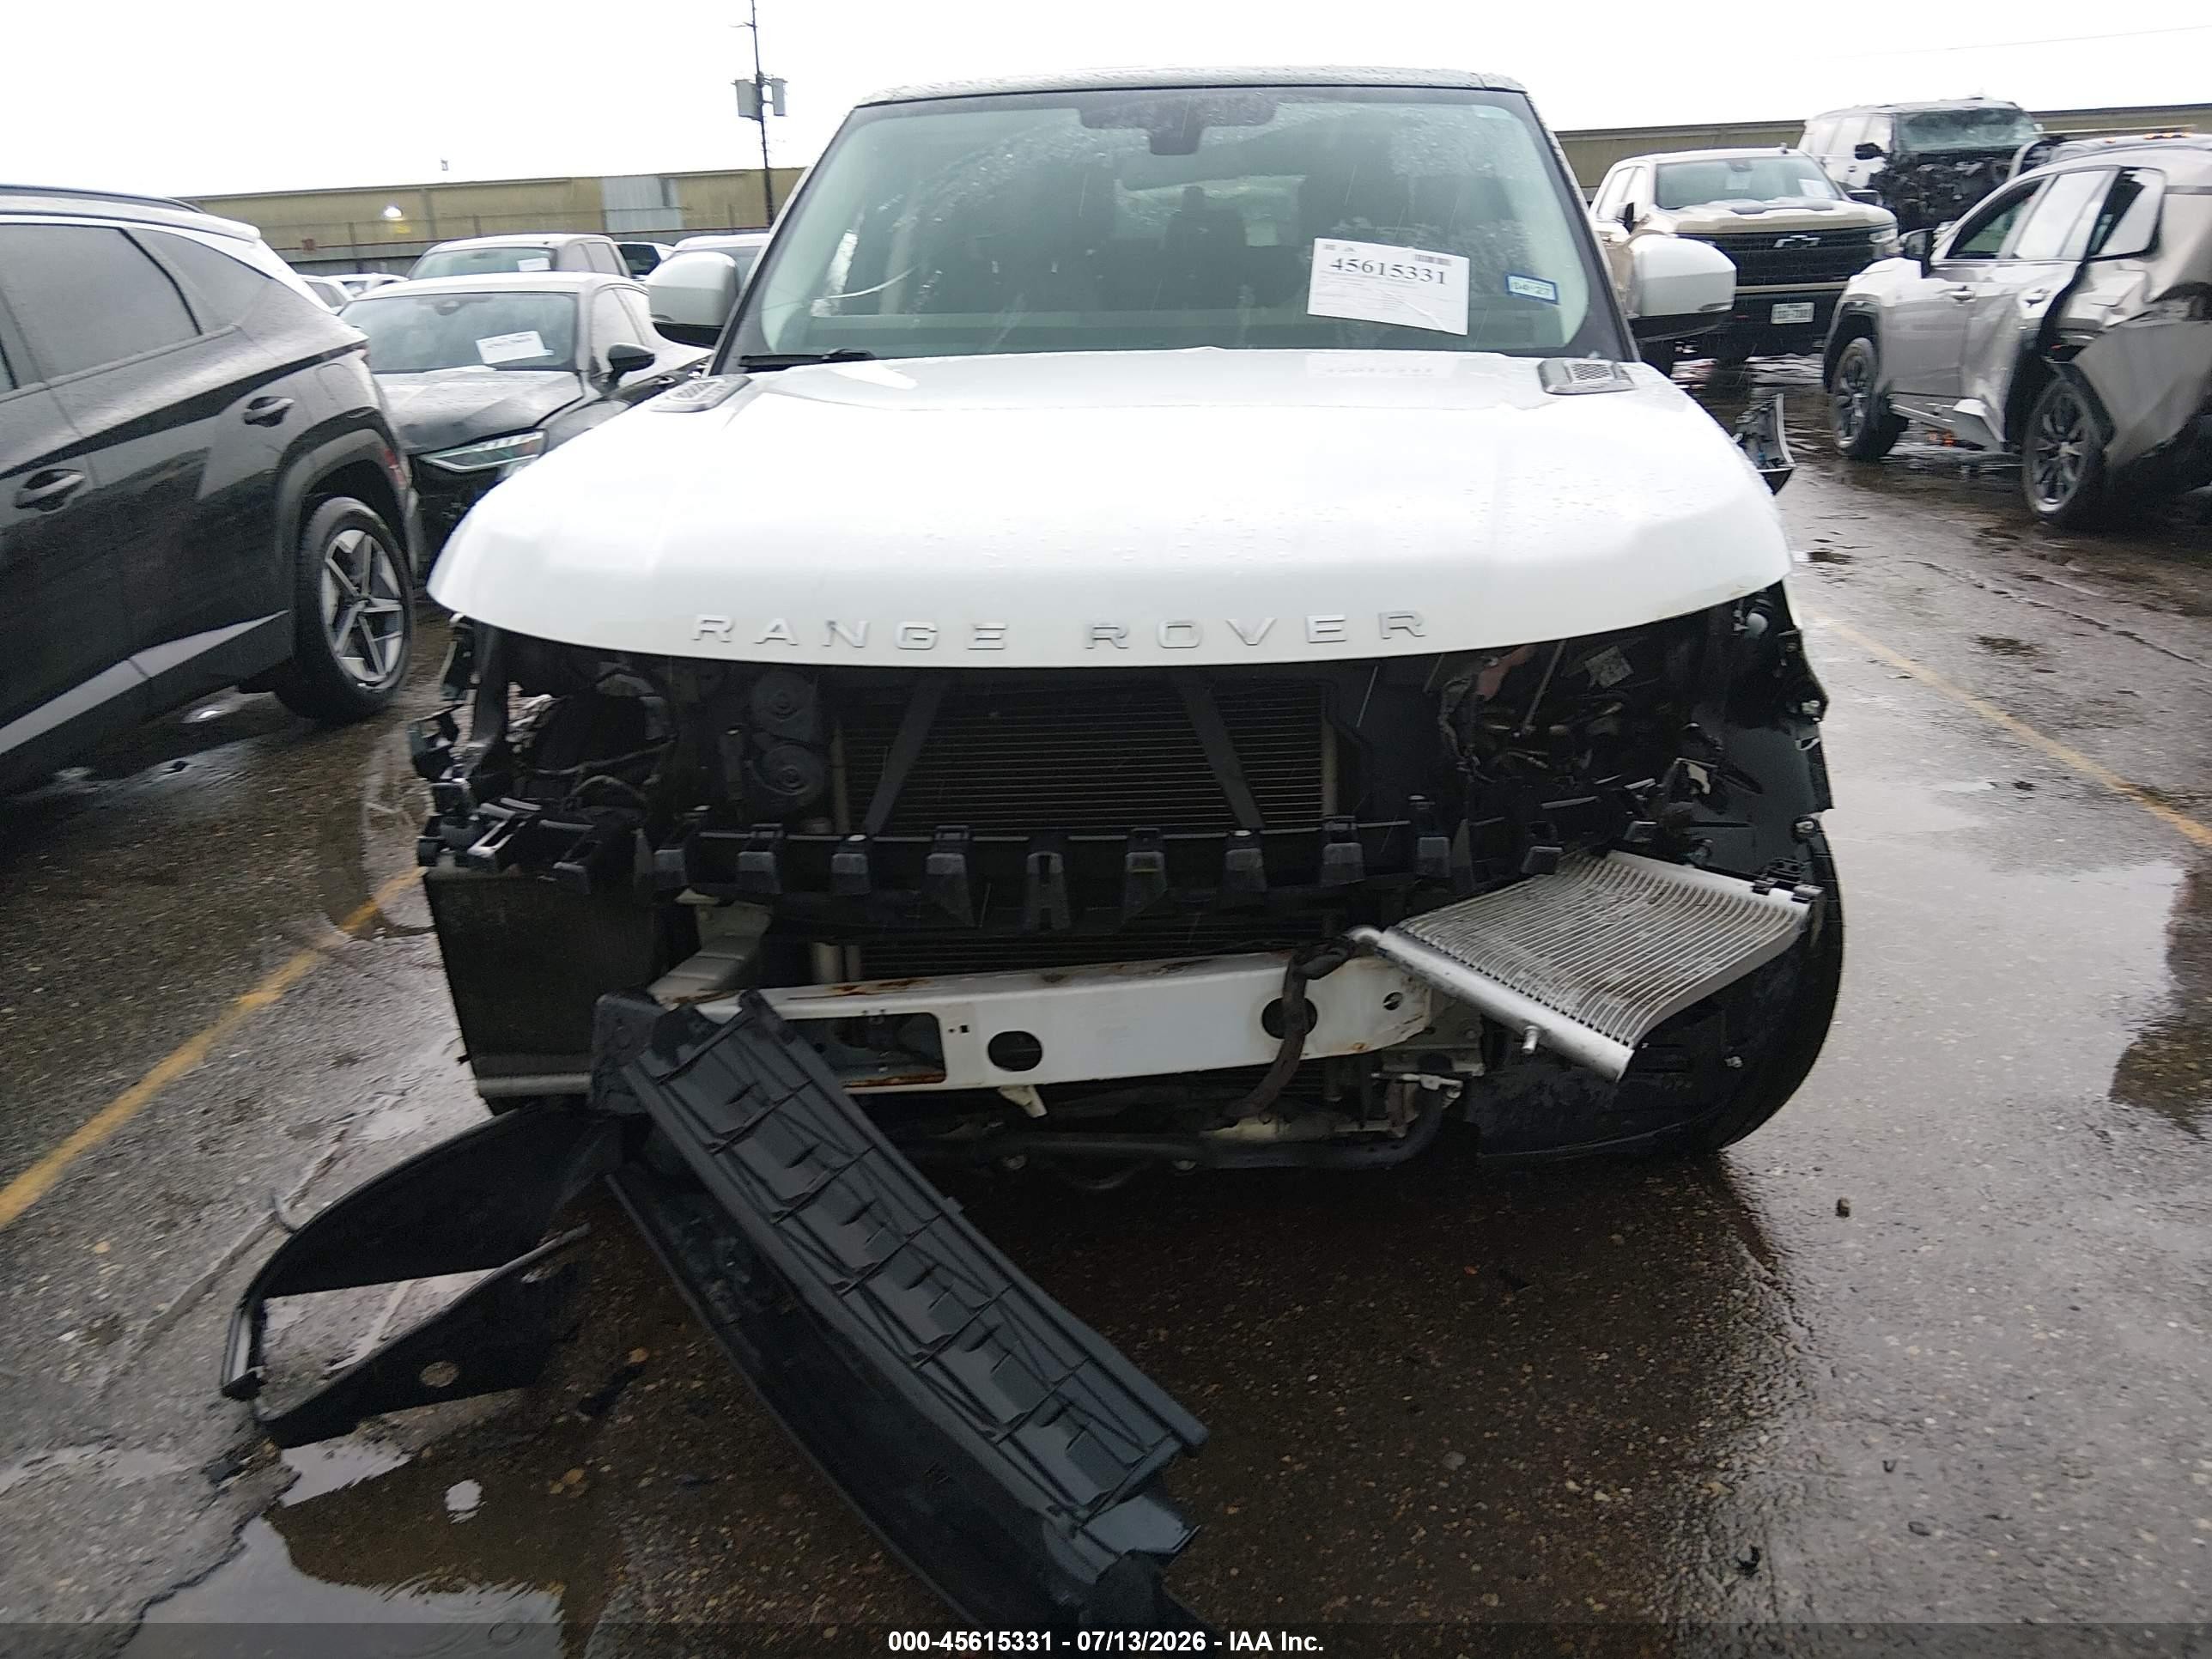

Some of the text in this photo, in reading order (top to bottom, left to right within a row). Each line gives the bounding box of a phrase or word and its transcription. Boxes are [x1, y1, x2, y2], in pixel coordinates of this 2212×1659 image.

[1330, 257, 1447, 285] 45615331
[691, 610, 1427, 650] RANGE ROVER
